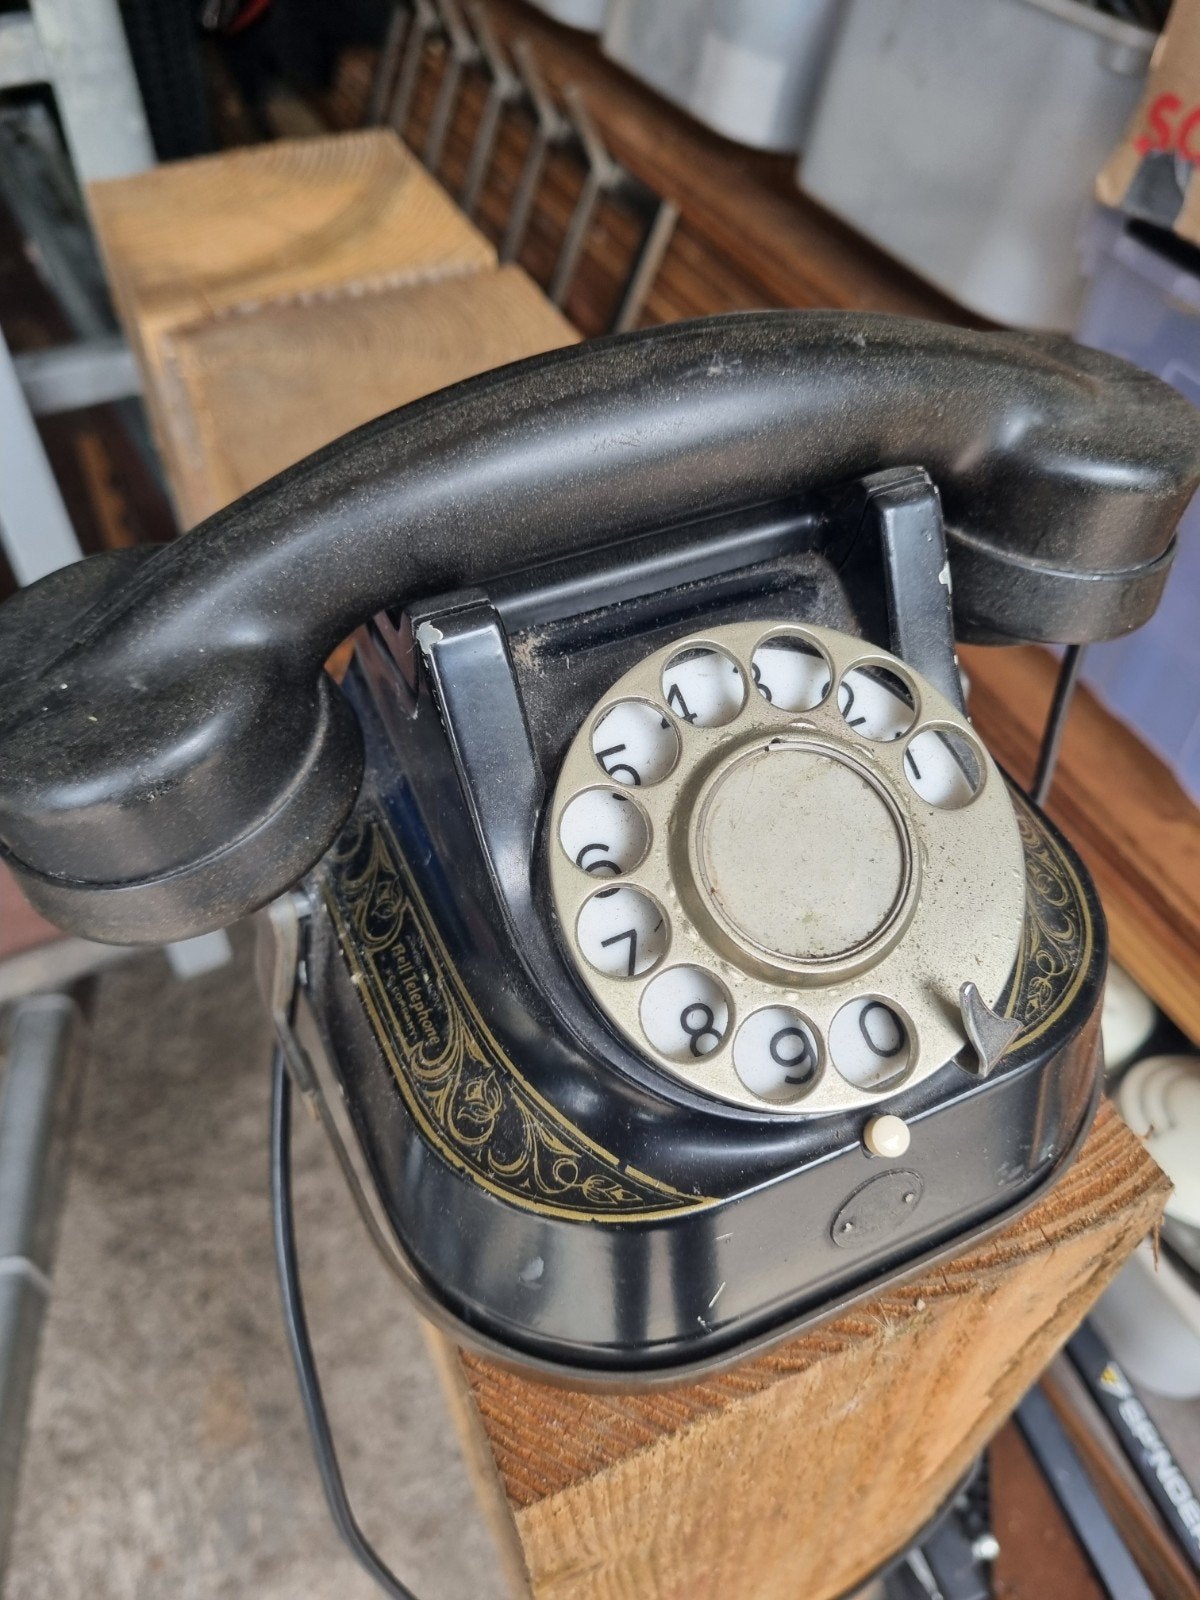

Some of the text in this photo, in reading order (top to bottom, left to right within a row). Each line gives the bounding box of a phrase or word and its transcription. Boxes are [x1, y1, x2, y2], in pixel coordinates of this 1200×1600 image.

[667, 683, 698, 724] 4
[595, 743, 642, 786] 5
[600, 928, 637, 977] 7
[403, 972, 440, 1045] Telephone
[680, 1002, 724, 1058] 8
[858, 1000, 905, 1058] 0
[769, 1027, 817, 1085] 9
